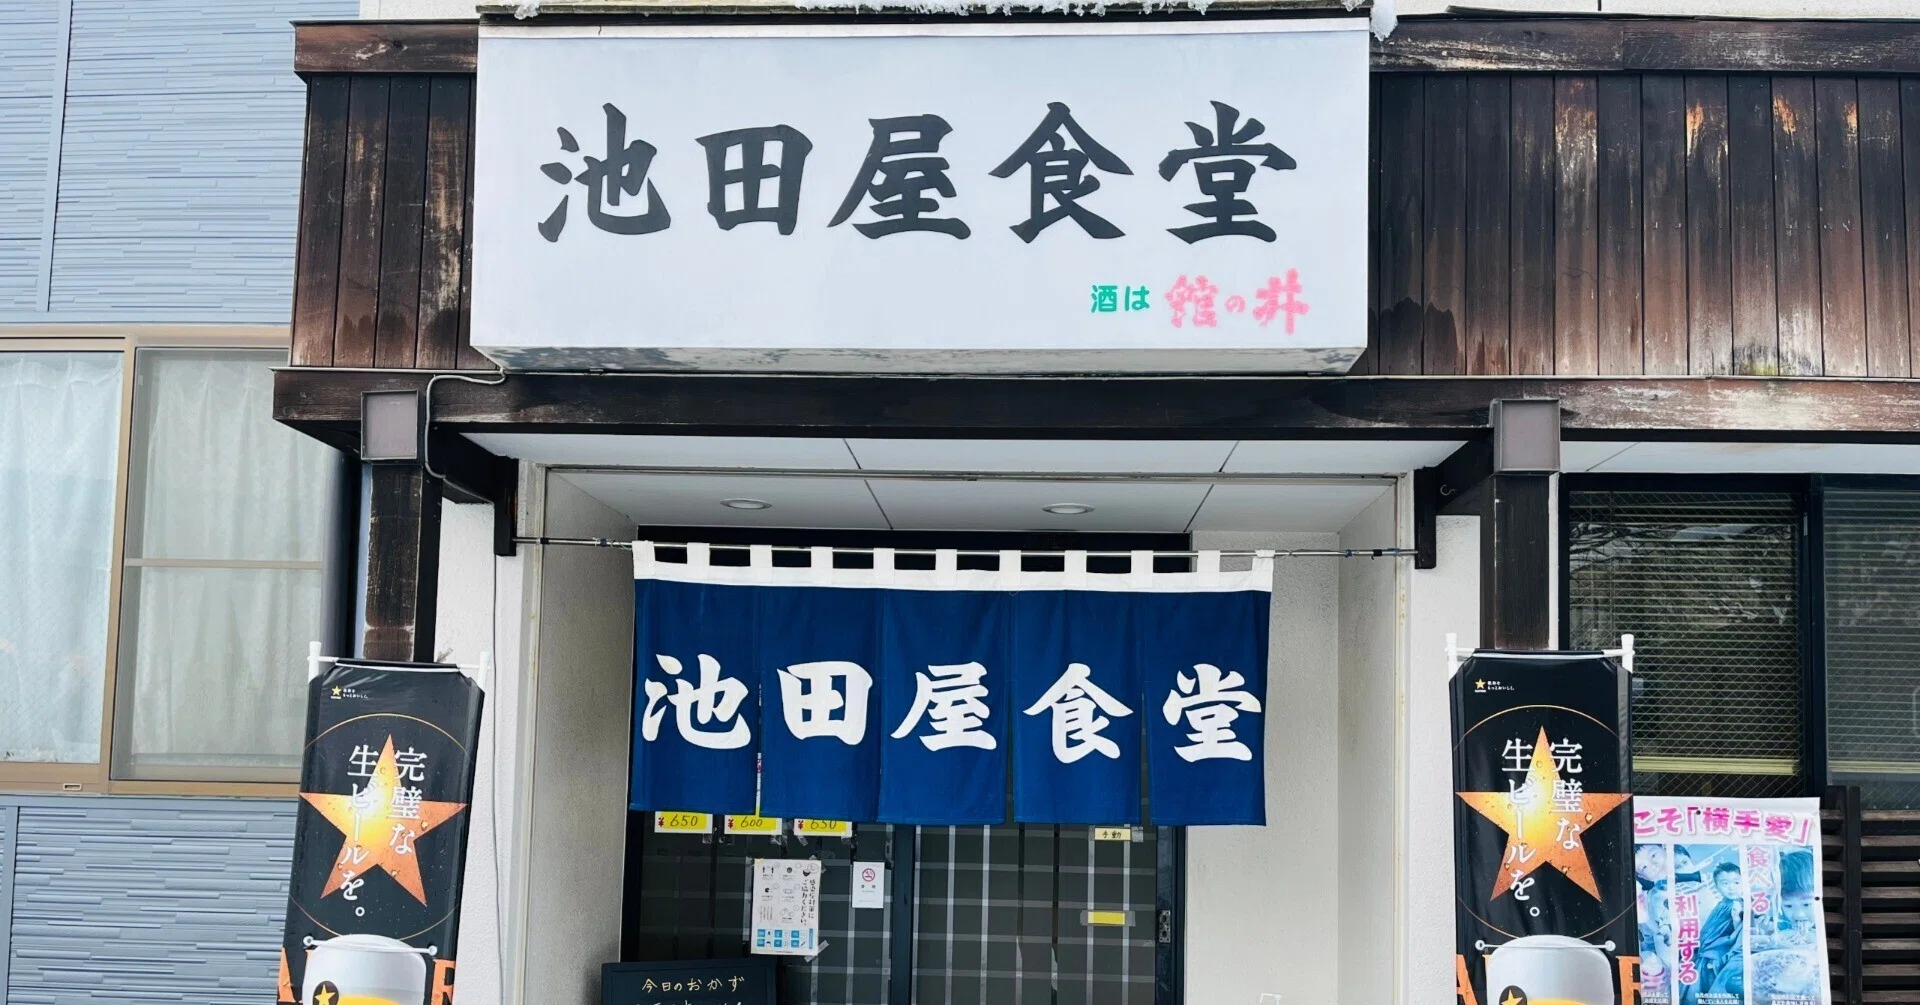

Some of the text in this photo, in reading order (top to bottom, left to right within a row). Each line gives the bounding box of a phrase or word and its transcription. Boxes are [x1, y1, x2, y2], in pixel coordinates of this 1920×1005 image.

[537, 100, 1298, 245] 池田屋食堂
[1091, 284, 1150, 313] 酒は
[641, 653, 1262, 764] 池田屋食堂
[339, 744, 380, 917] 生ビールを。
[388, 747, 428, 855] 完璧な
[1501, 737, 1541, 918] 生ビールを。
[1549, 738, 1584, 851] 完璧な
[1747, 846, 1773, 914] 食べる
[641, 975, 745, 993] 今日のおかず
[1675, 894, 1699, 984] 利用する
